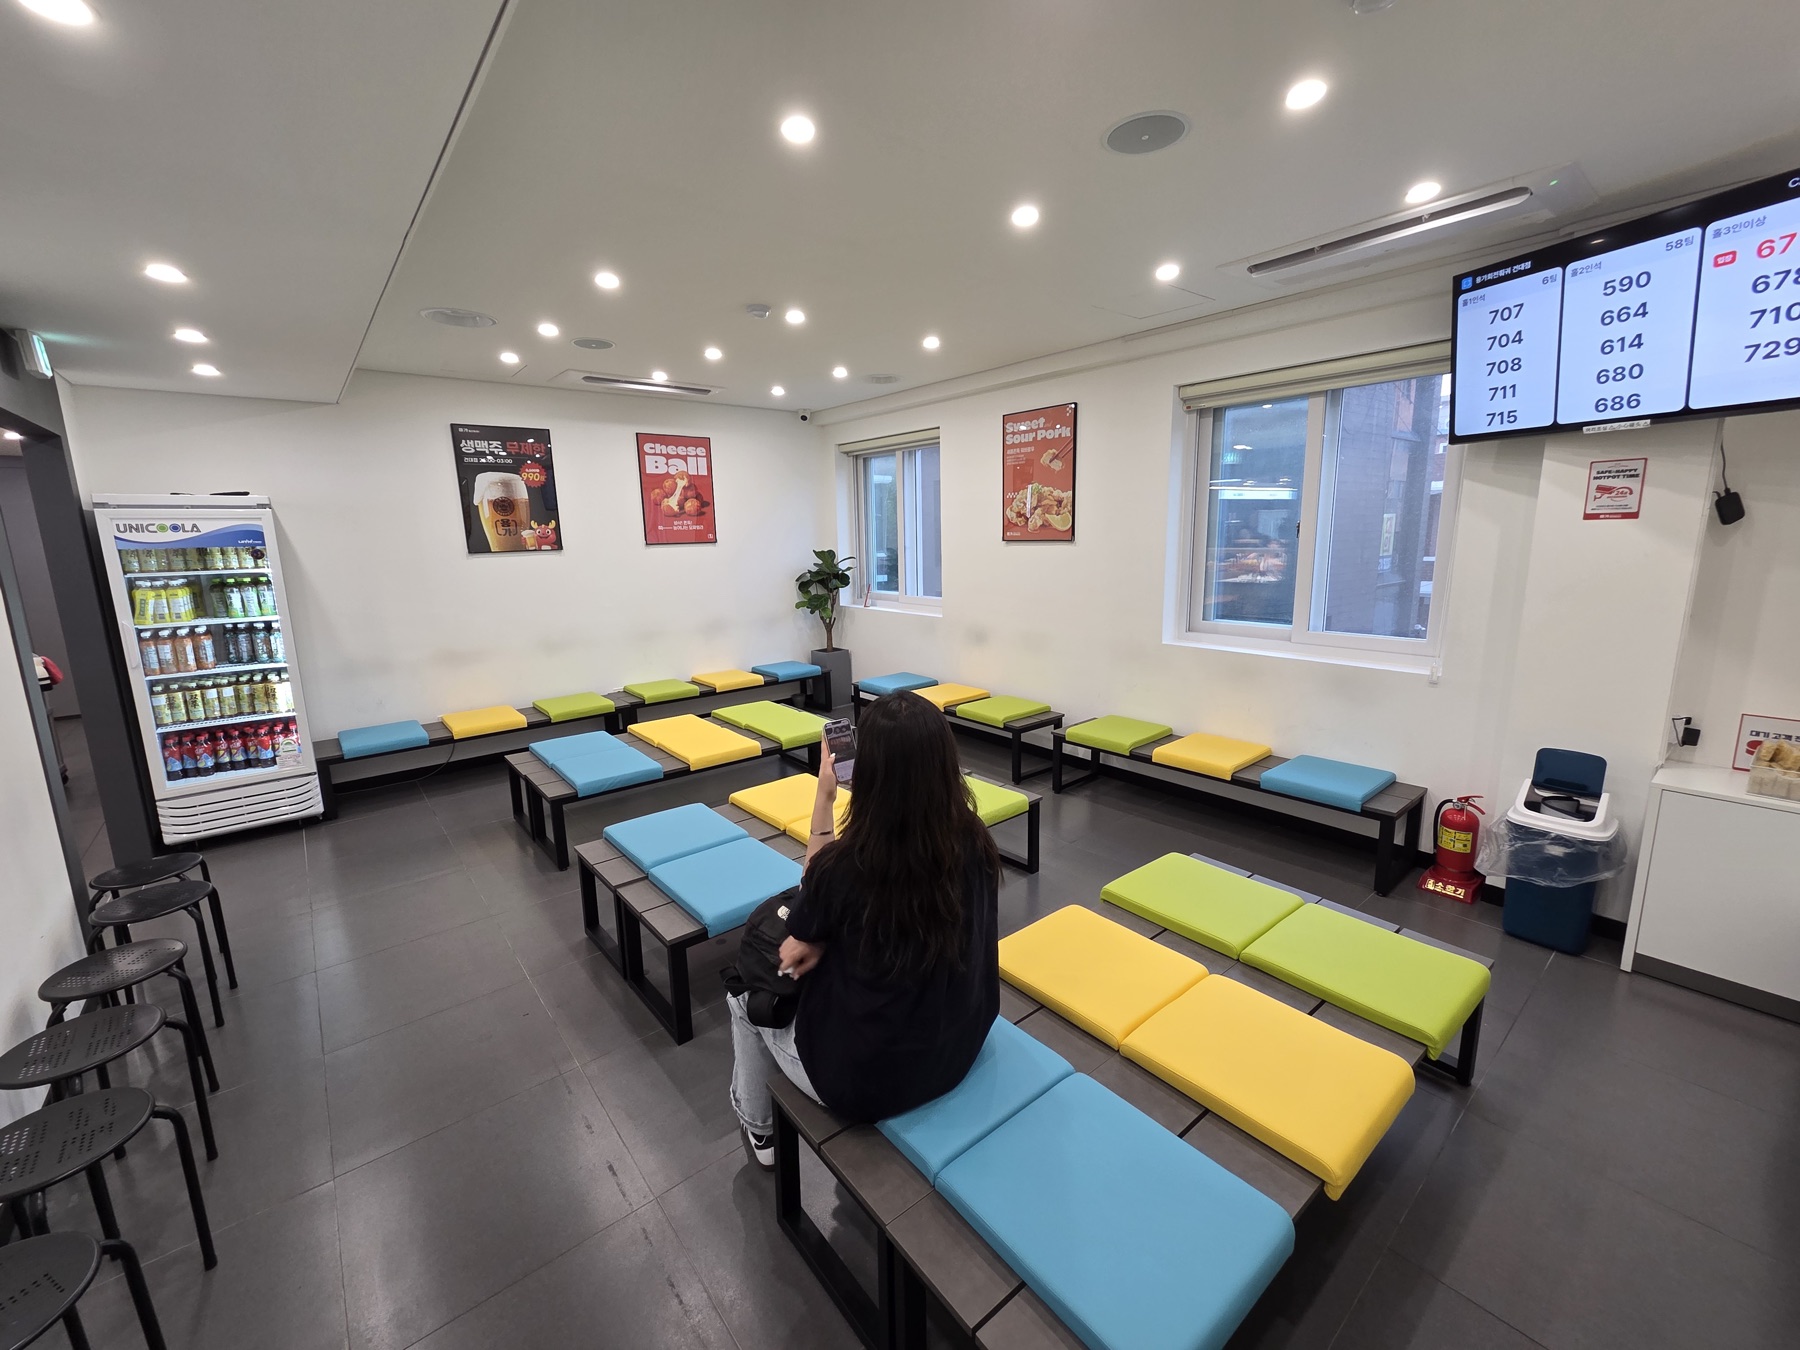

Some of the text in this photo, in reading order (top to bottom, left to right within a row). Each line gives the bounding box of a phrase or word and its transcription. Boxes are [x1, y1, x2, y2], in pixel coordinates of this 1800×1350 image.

[1712, 215, 1767, 239] 홀3인이상
[1665, 235, 1695, 252] 58팀
[1570, 261, 1602, 278] 홀2인석
[1542, 274, 1558, 285] 6팀
[1602, 271, 1652, 297] 590
[1462, 294, 1486, 308] 홀1인석
[1489, 303, 1524, 325] 707
[1600, 301, 1649, 326] 664
[1749, 301, 1800, 329] 710
[1487, 330, 1524, 351] 704
[1600, 333, 1644, 355] 614
[1744, 337, 1800, 363] 729
[1486, 357, 1522, 376] 708
[1596, 363, 1644, 385] 680
[1489, 384, 1517, 401] 711
[1594, 393, 1642, 413] 686
[1006, 417, 1045, 433] Sweet
[1486, 410, 1518, 426] 715
[1006, 426, 1071, 445] Sour Pork
[460, 439, 545, 456] 생맥주 무제한
[643, 442, 706, 456] Cheese
[644, 455, 708, 476] Ball
[1435, 881, 1466, 896] 소화기
